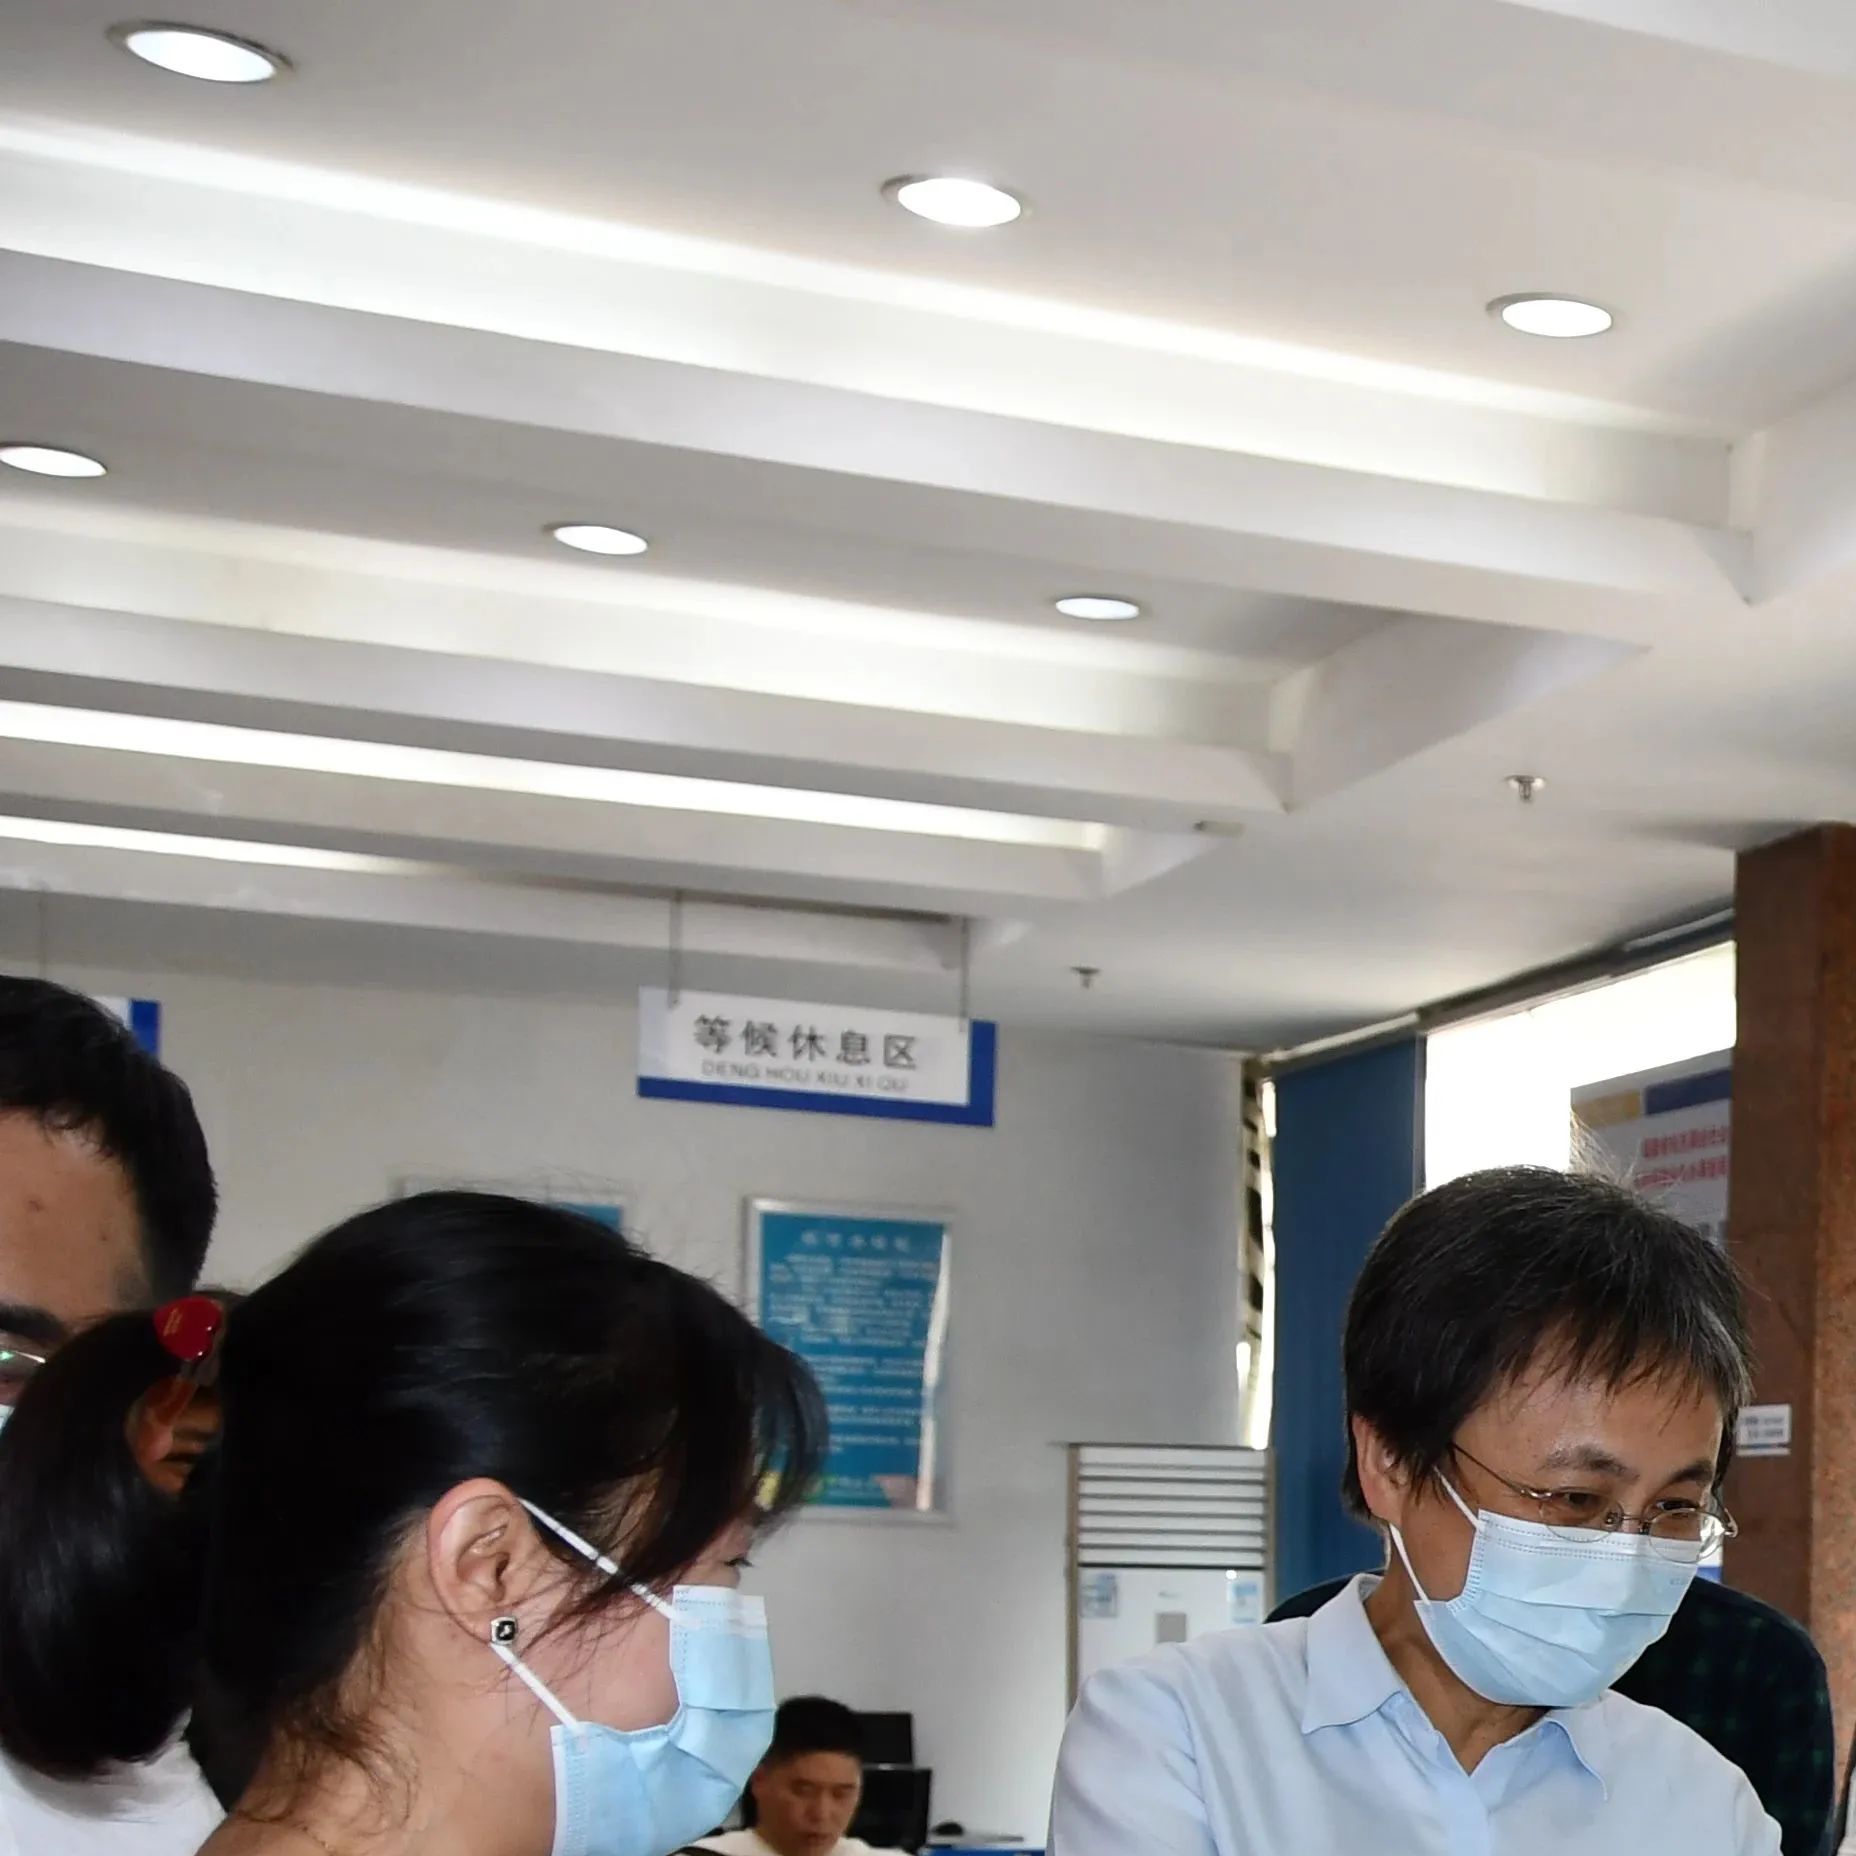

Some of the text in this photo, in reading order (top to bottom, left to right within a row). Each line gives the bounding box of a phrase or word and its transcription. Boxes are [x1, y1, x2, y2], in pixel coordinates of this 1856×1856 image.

[693, 1013, 919, 1071] 等候休息区
[701, 1060, 762, 1081] DENG
[766, 1066, 809, 1084] HOU
[816, 1070, 849, 1087] XIU
[876, 1074, 909, 1091] QU
